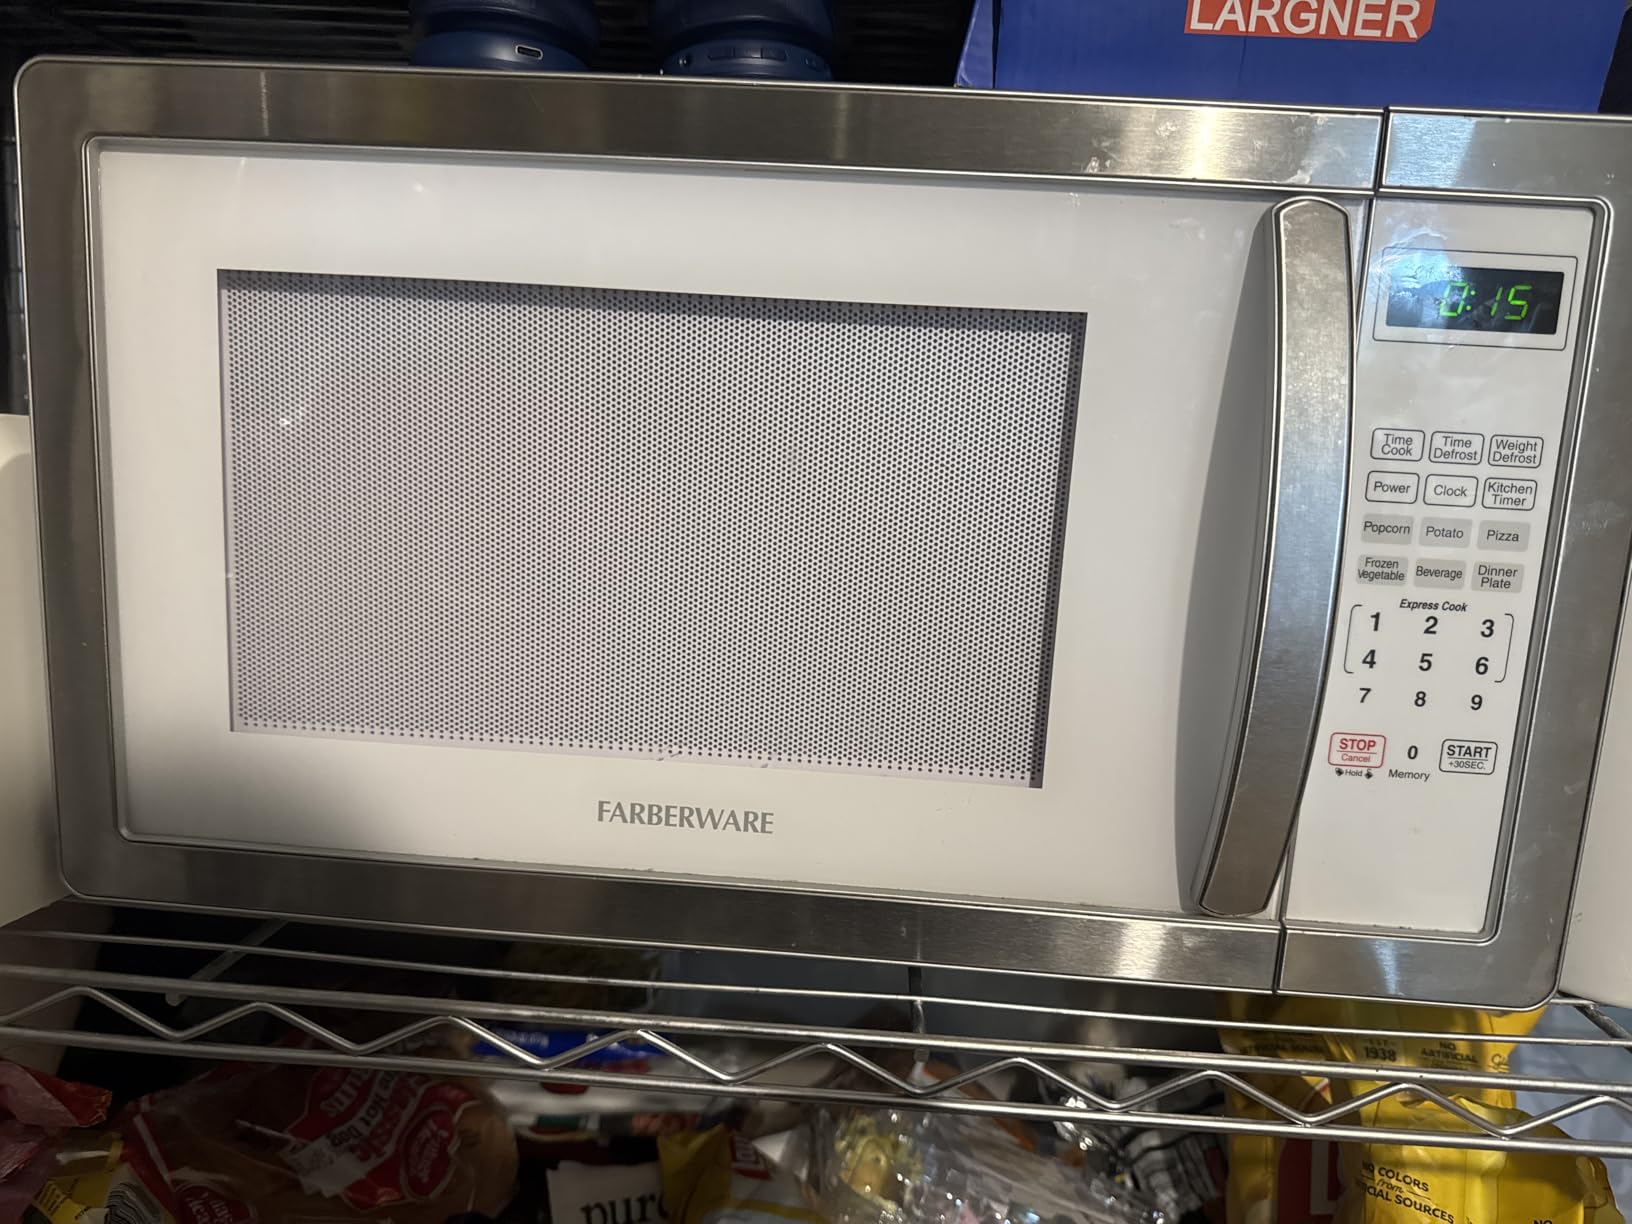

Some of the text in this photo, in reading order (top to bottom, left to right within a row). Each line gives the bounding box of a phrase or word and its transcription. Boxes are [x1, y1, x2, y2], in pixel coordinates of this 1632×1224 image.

[1190, 0, 1421, 39] LARGNER
[1439, 280, 1532, 320] 0:15
[1384, 433, 1413, 446] Time
[1442, 436, 1472, 449] Time
[1381, 444, 1413, 457] Cook
[1433, 447, 1478, 461] Defrost
[1495, 439, 1538, 455] Weight
[1492, 451, 1537, 464] Defrost
[1373, 481, 1411, 494] Power
[1433, 484, 1468, 497] Clock
[1487, 481, 1533, 495] Kitchen
[1491, 494, 1527, 507] Timer
[1363, 521, 1411, 535] Popcorn
[1425, 526, 1464, 539] Potato
[1486, 530, 1519, 542] Pizza
[1364, 557, 1399, 569] Frozen
[1358, 569, 1405, 582] Vegetable
[1415, 566, 1463, 581] Beverage
[1478, 565, 1518, 577] Dinner
[1480, 576, 1511, 589] Plate
[1399, 599, 1468, 613] Express Cook
[1369, 612, 1495, 638] 1 2 3
[1361, 649, 1489, 675] 4 5 6
[1359, 687, 1483, 711] 7 8 9
[1339, 738, 1377, 752] STOP
[1446, 744, 1492, 759] START
[1341, 753, 1371, 763] Cancel
[1407, 745, 1419, 760] 0
[1345, 768, 1363, 778] Hold
[1388, 769, 1430, 782] Memory
[597, 800, 775, 834] FARBERWARE
[1364, 1045, 1396, 1063] 1938
[1378, 1166, 1429, 1192] COLORS
[1394, 1194, 1455, 1224] SOURCES
